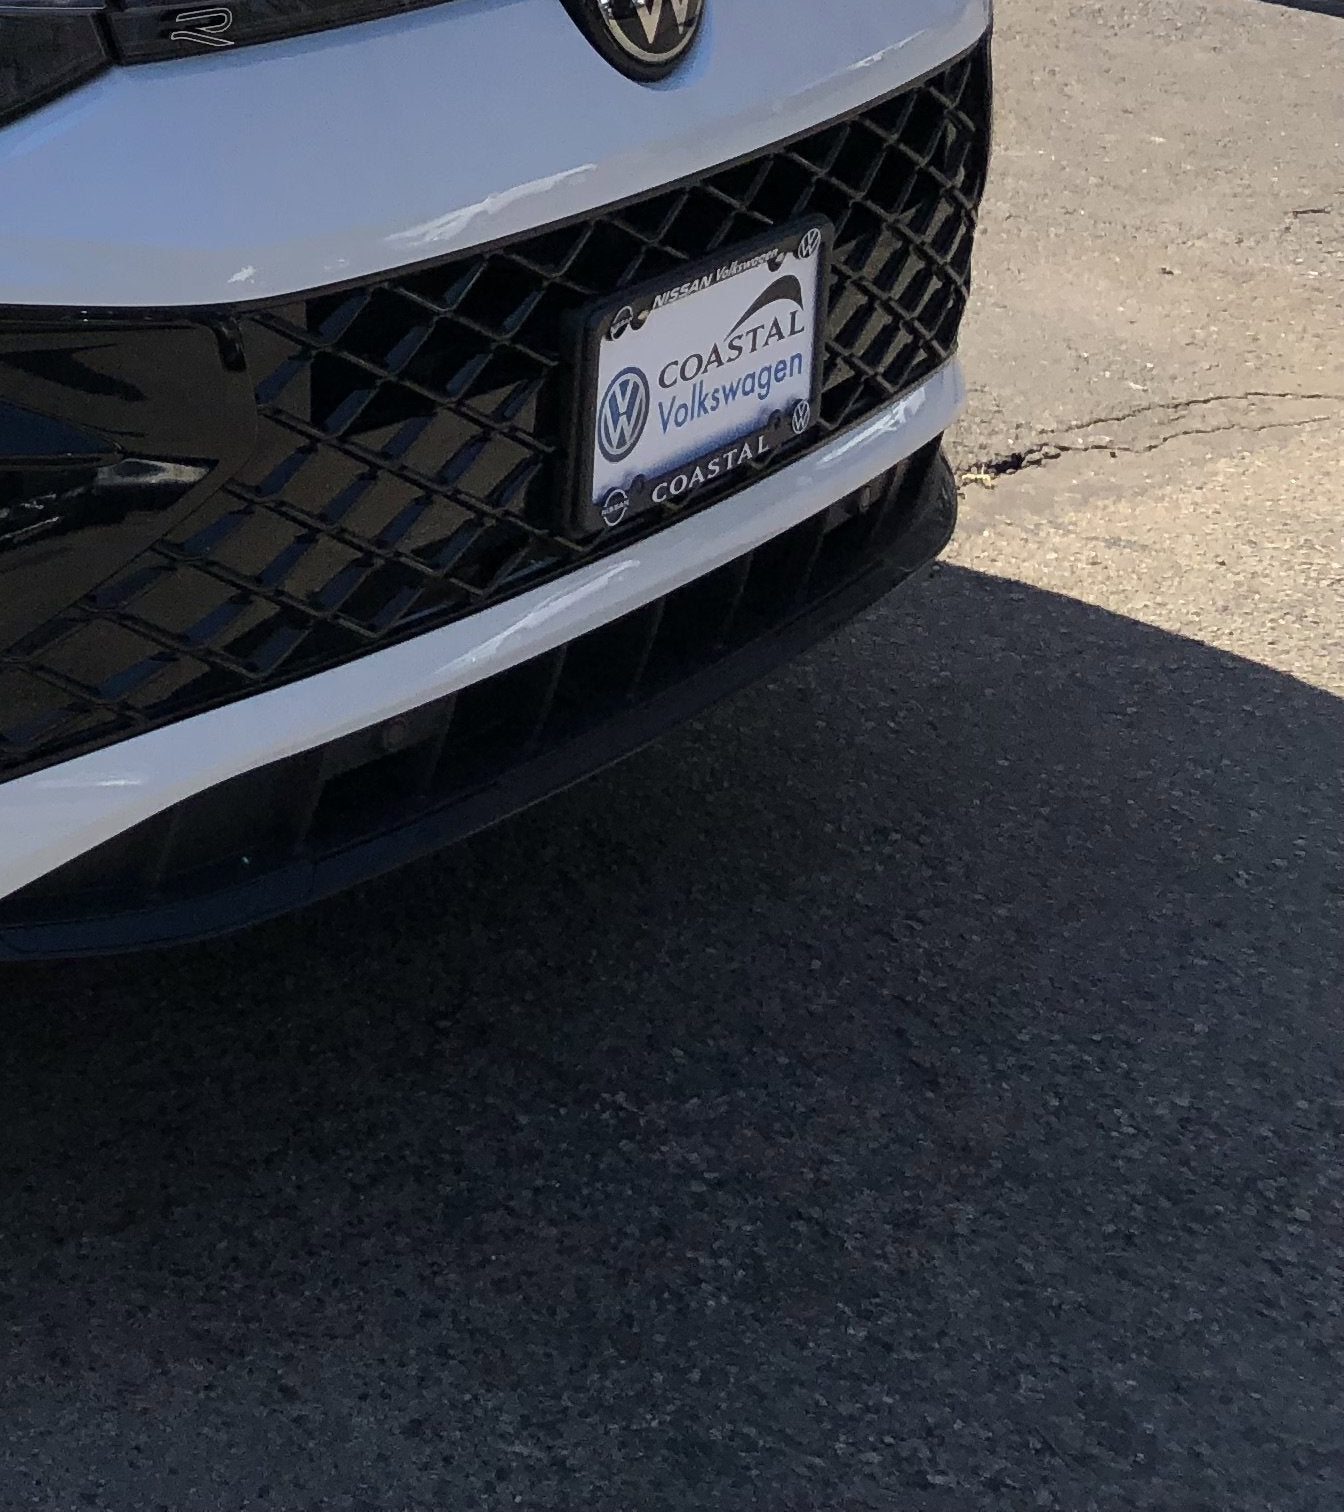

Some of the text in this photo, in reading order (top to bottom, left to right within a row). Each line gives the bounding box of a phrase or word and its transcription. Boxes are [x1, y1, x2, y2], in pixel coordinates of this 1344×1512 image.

[652, 273, 713, 310] NISSAN
[658, 309, 805, 389] COASTAL
[658, 352, 803, 434] Volkswagen
[652, 433, 770, 504] COASTAL
